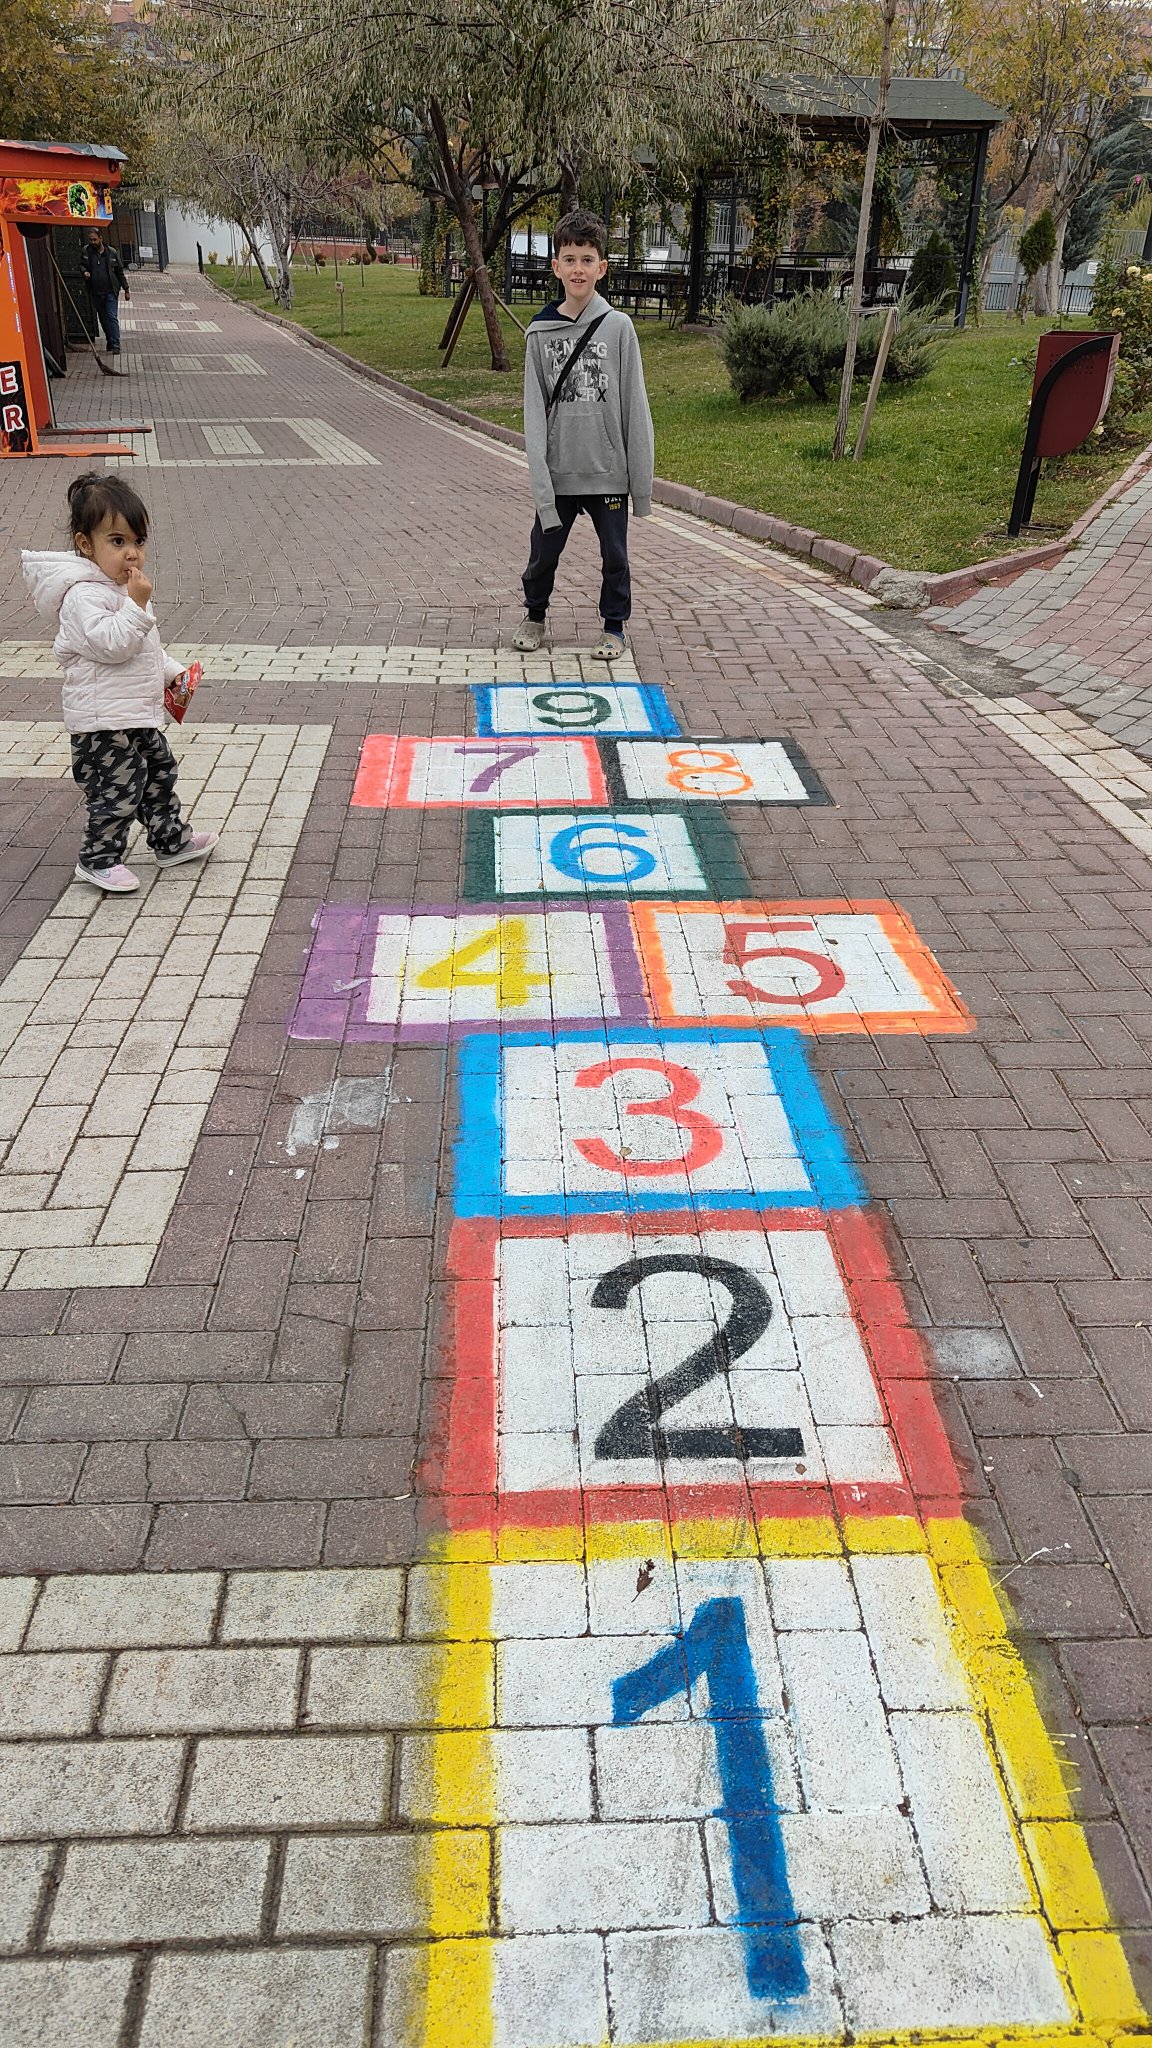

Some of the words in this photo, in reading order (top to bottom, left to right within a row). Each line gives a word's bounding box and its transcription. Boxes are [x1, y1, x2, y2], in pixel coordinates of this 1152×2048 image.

[3, 405, 25, 432] R
[532, 691, 611, 727] 9
[454, 747, 540, 792] 7
[666, 750, 753, 795] 8
[549, 822, 657, 882] 6
[415, 917, 551, 1008] 4
[723, 922, 845, 1004] 5
[572, 1058, 723, 1176] 3
[590, 1254, 806, 1460] 2
[611, 1596, 810, 2000] 1
